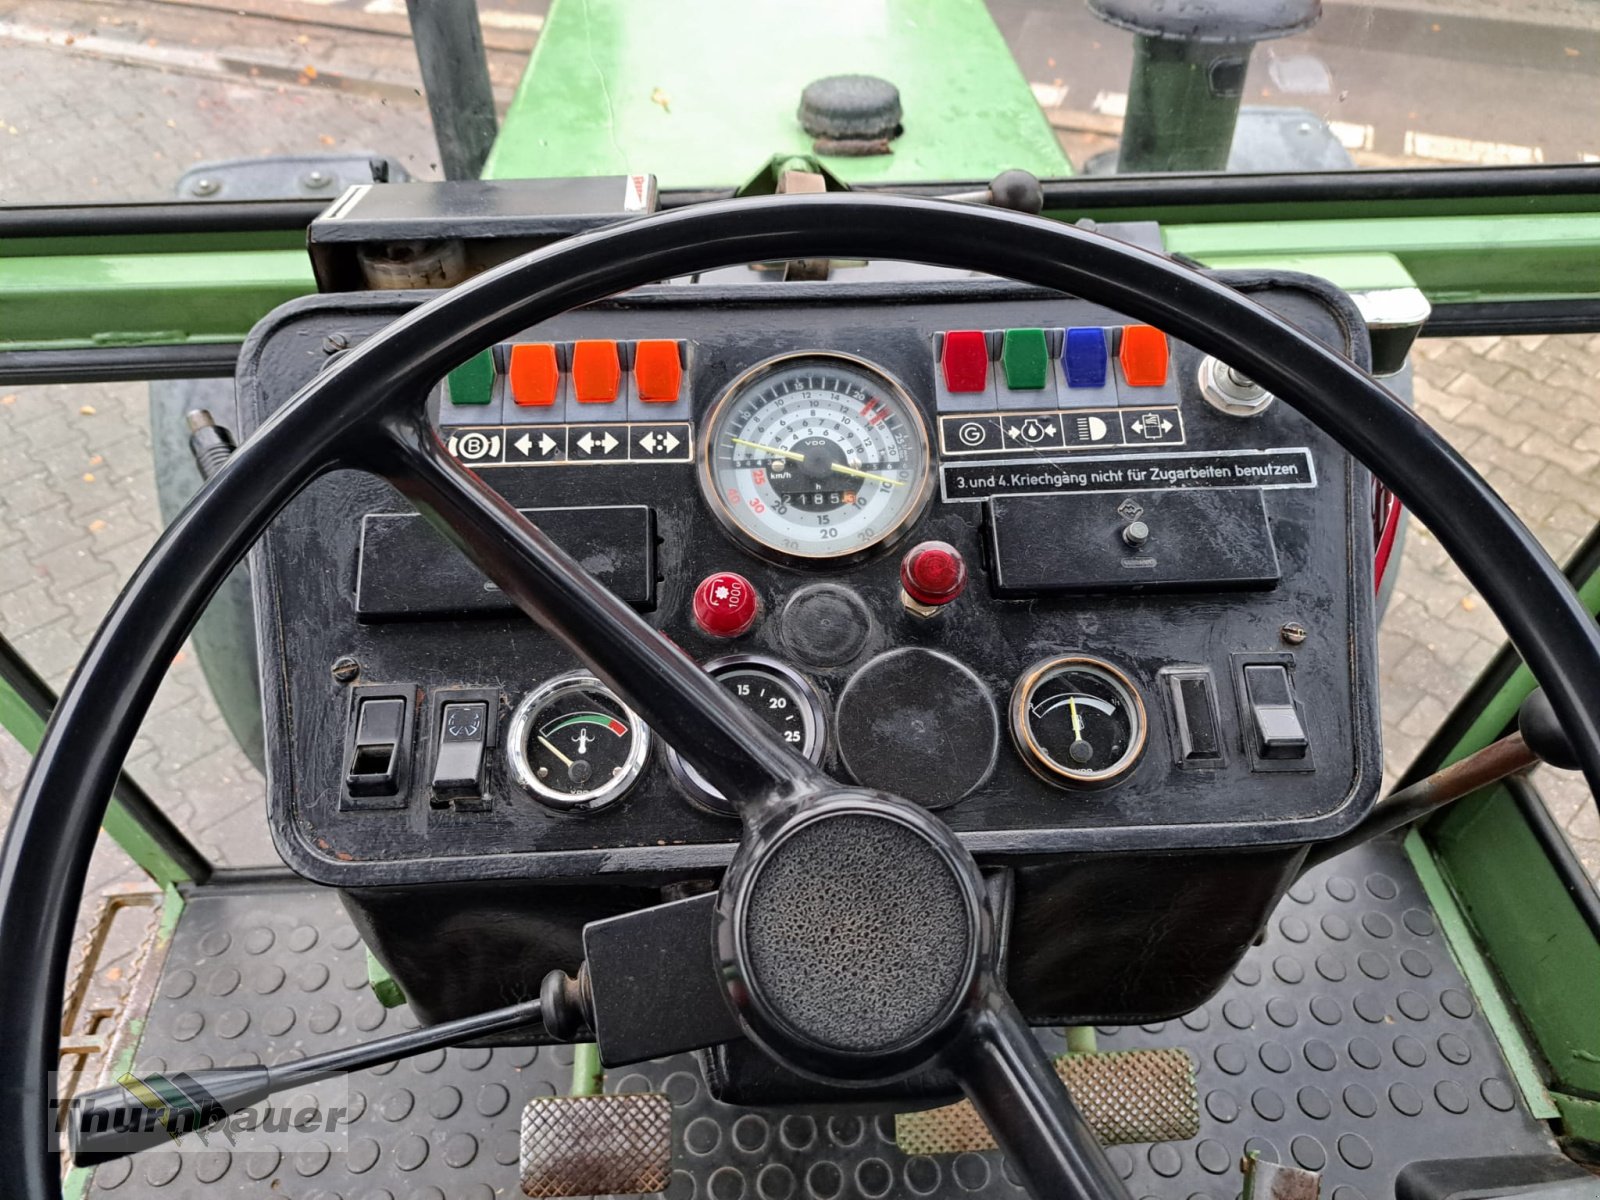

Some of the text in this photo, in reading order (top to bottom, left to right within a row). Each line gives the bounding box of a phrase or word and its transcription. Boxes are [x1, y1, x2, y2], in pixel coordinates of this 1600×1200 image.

[752, 470, 766, 486] 25
[771, 471, 792, 480] km/h
[1091, 470, 1123, 482] nicht
[1127, 468, 1147, 481] für
[1149, 466, 1231, 483] Zugarbeiten
[1235, 463, 1298, 477] benutzen
[880, 480, 893, 494] 10
[749, 498, 765, 513] 30
[771, 500, 788, 515] 20
[855, 497, 868, 510] 10
[817, 515, 830, 525] 15
[820, 528, 838, 539] 20
[857, 527, 874, 541] 20
[728, 582, 742, 608] 1000
[737, 684, 750, 695] 15
[769, 697, 787, 709] 20
[784, 730, 801, 742] 25
